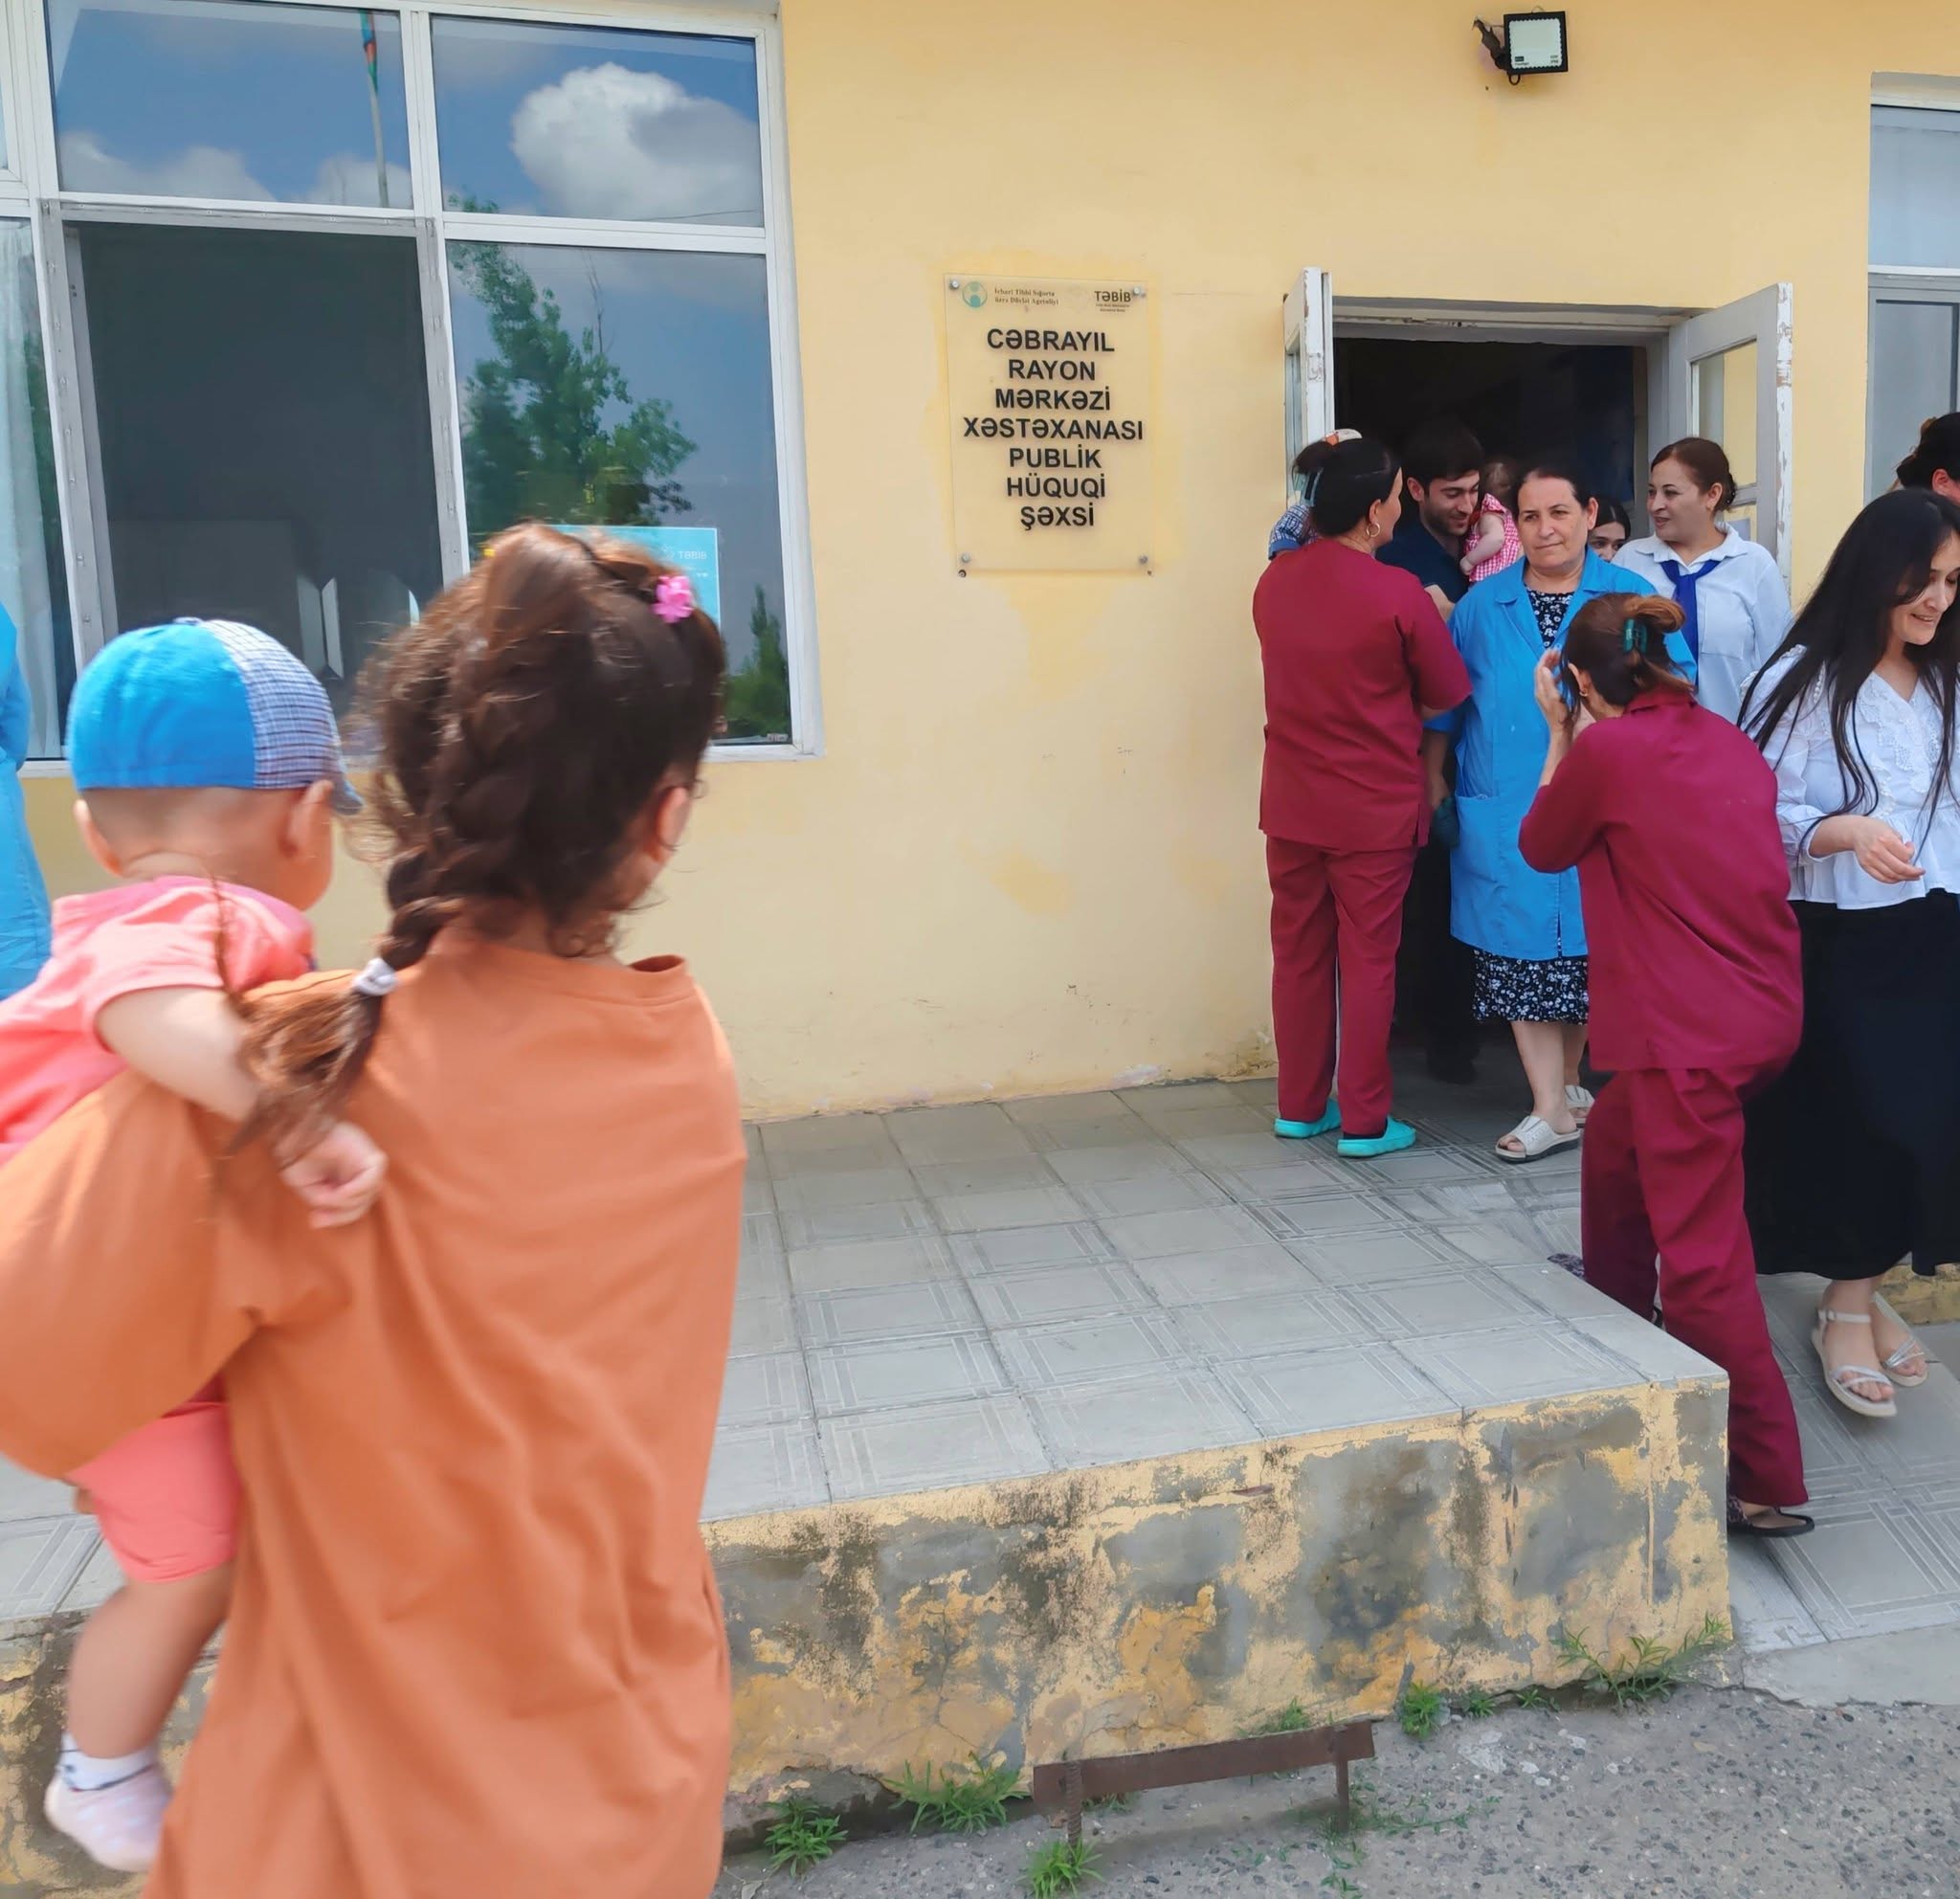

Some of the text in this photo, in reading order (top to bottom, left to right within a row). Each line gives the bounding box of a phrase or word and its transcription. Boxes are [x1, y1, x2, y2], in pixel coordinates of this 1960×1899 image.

[1094, 288, 1131, 302] TƏBİB
[988, 328, 1115, 352] CƏBRAYIL
[1008, 359, 1096, 381] RAYON
[995, 386, 1110, 411] MƏRKƏZİ
[964, 417, 1143, 440] XƏSTƏXANASI
[1010, 444, 1102, 469] PUBLİK
[1007, 473, 1105, 499] HÜQUQİ
[1020, 503, 1094, 531] ŞƏXSİ
